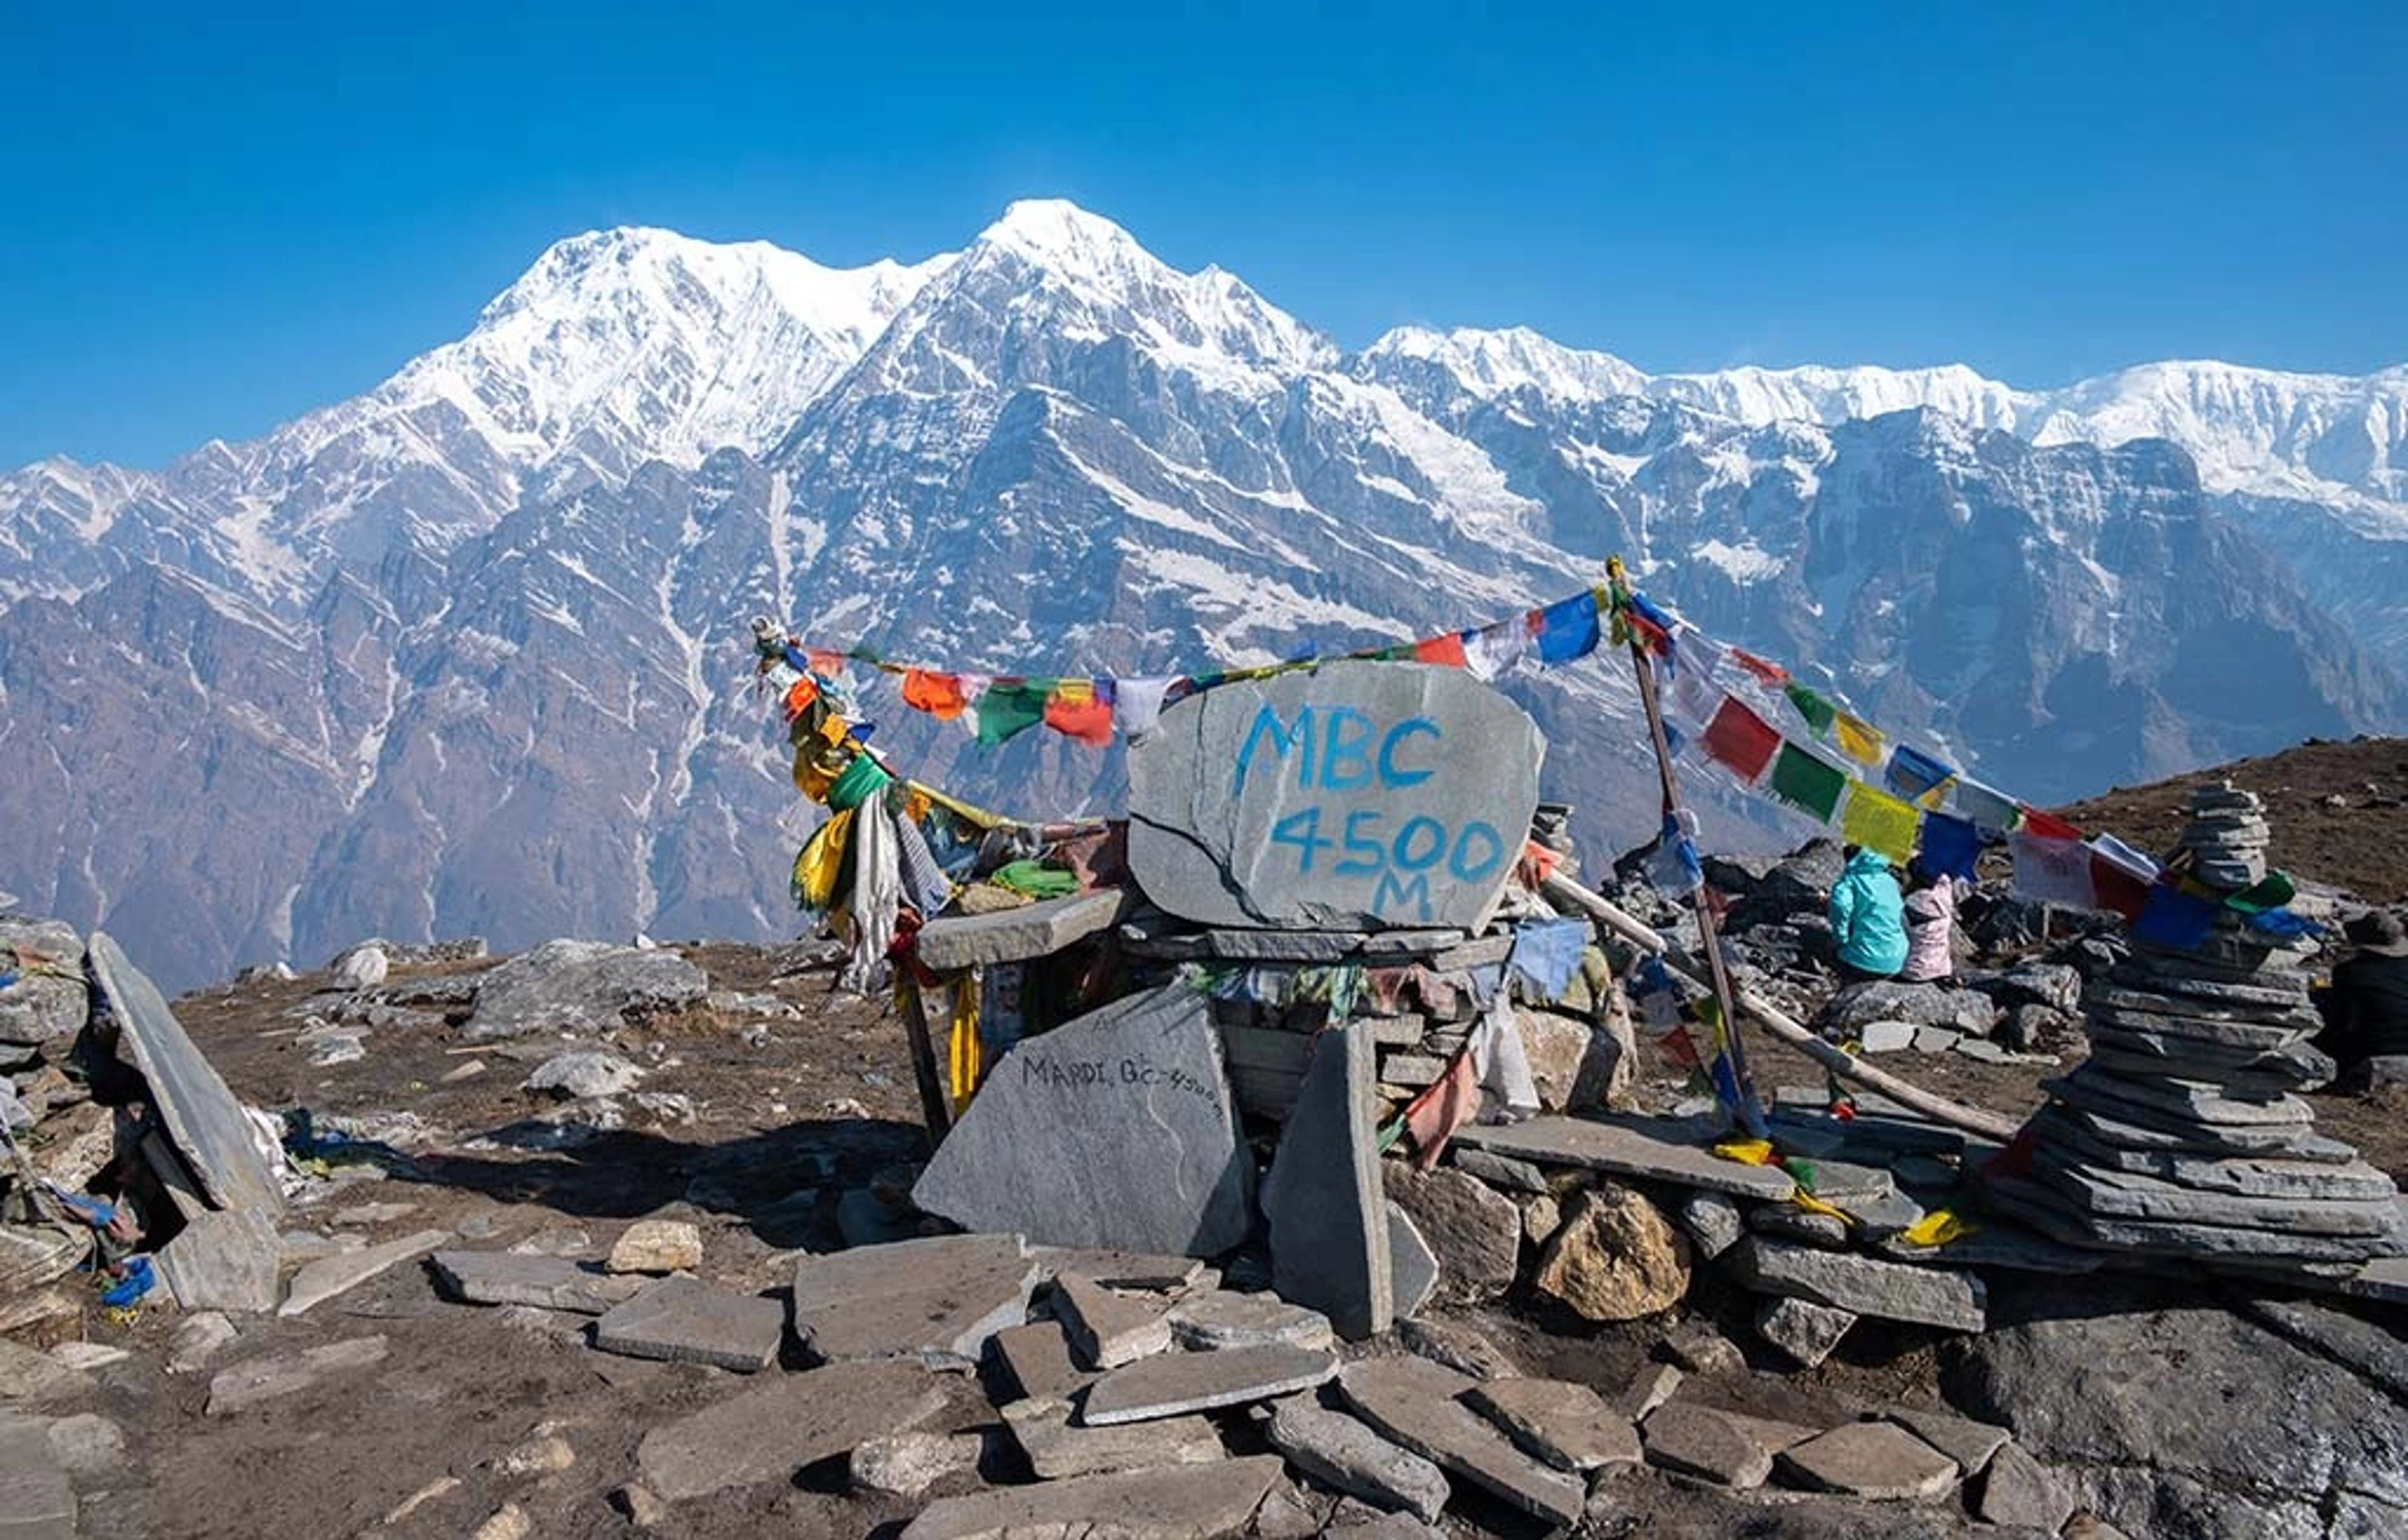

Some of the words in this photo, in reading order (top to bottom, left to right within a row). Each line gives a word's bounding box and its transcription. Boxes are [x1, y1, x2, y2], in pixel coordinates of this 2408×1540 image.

[1234, 702, 1441, 799] MBC
[1272, 806, 1502, 884] 4500
[1373, 869, 1431, 921] M
